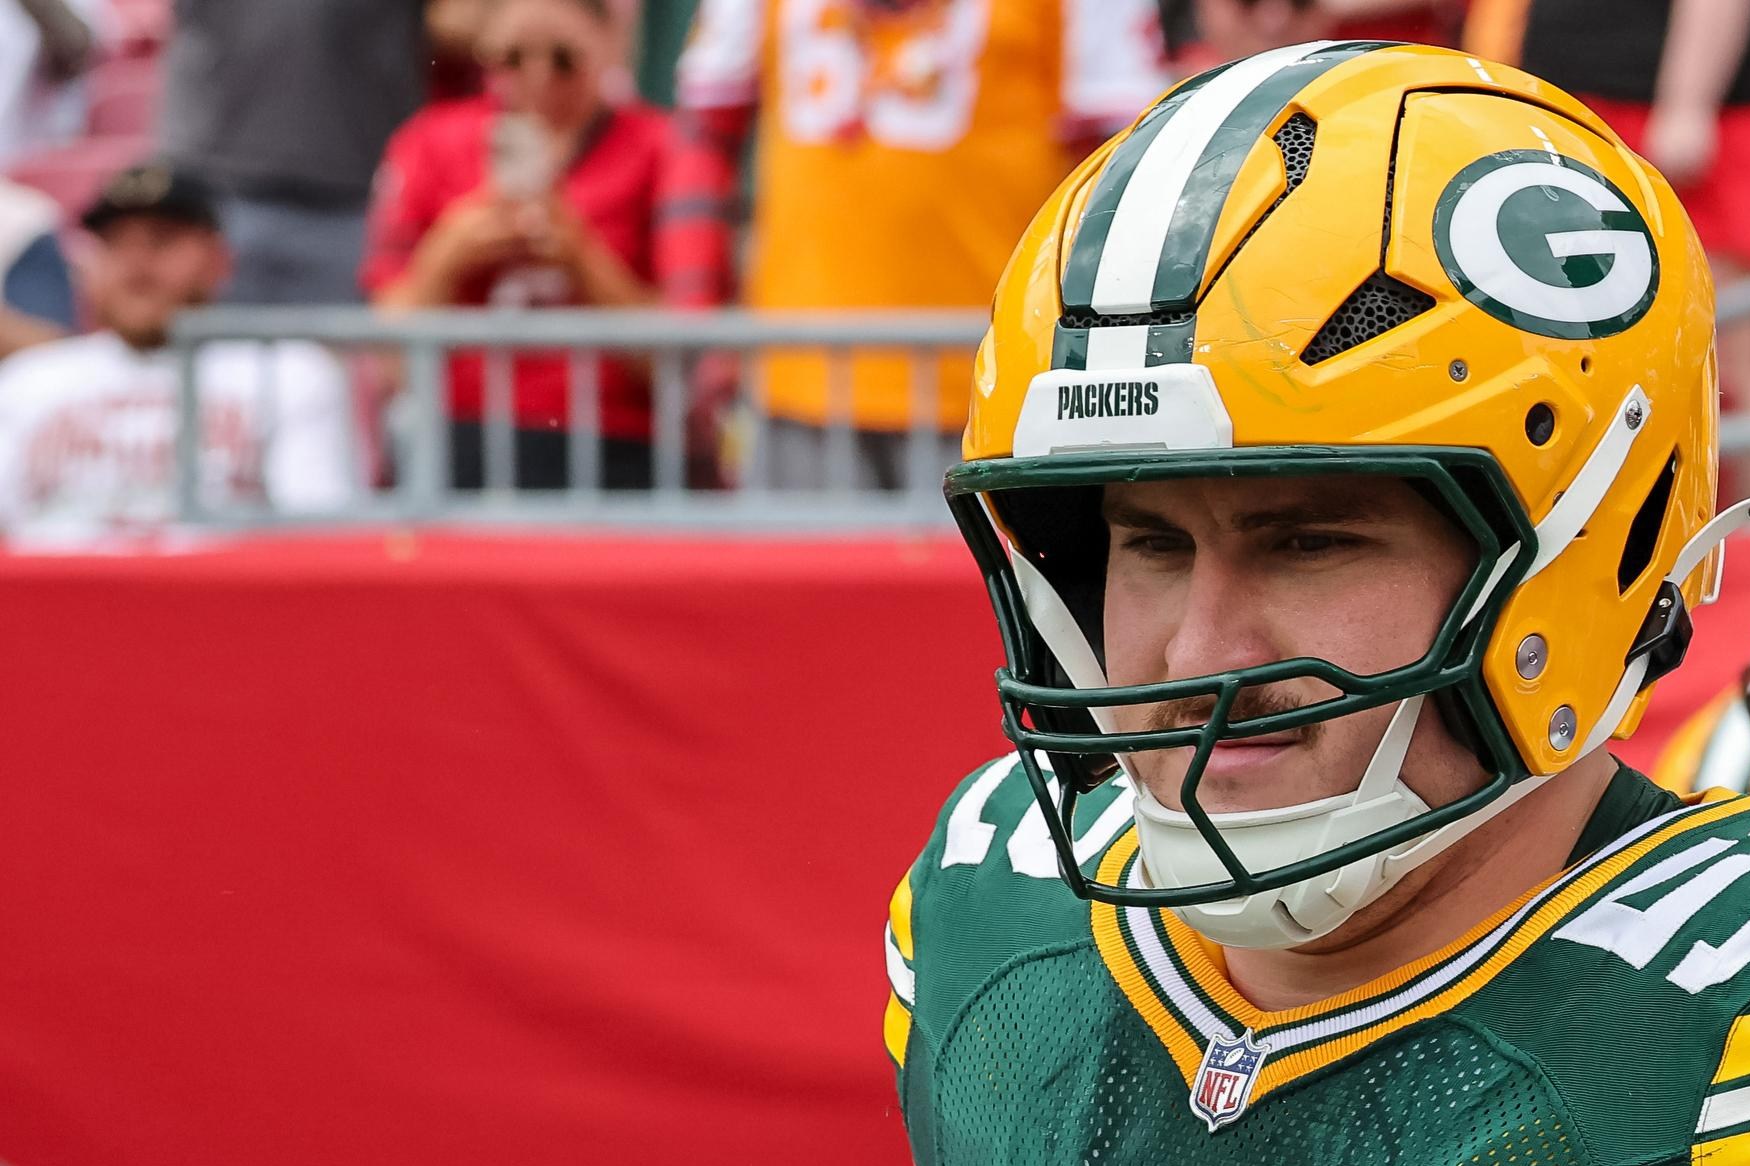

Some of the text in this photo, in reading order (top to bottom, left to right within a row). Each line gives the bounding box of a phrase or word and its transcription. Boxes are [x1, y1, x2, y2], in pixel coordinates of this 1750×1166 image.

[1450, 162, 1653, 323] G
[1057, 382, 1159, 420] PACKERS
[1198, 1070, 1241, 1114] NFL
